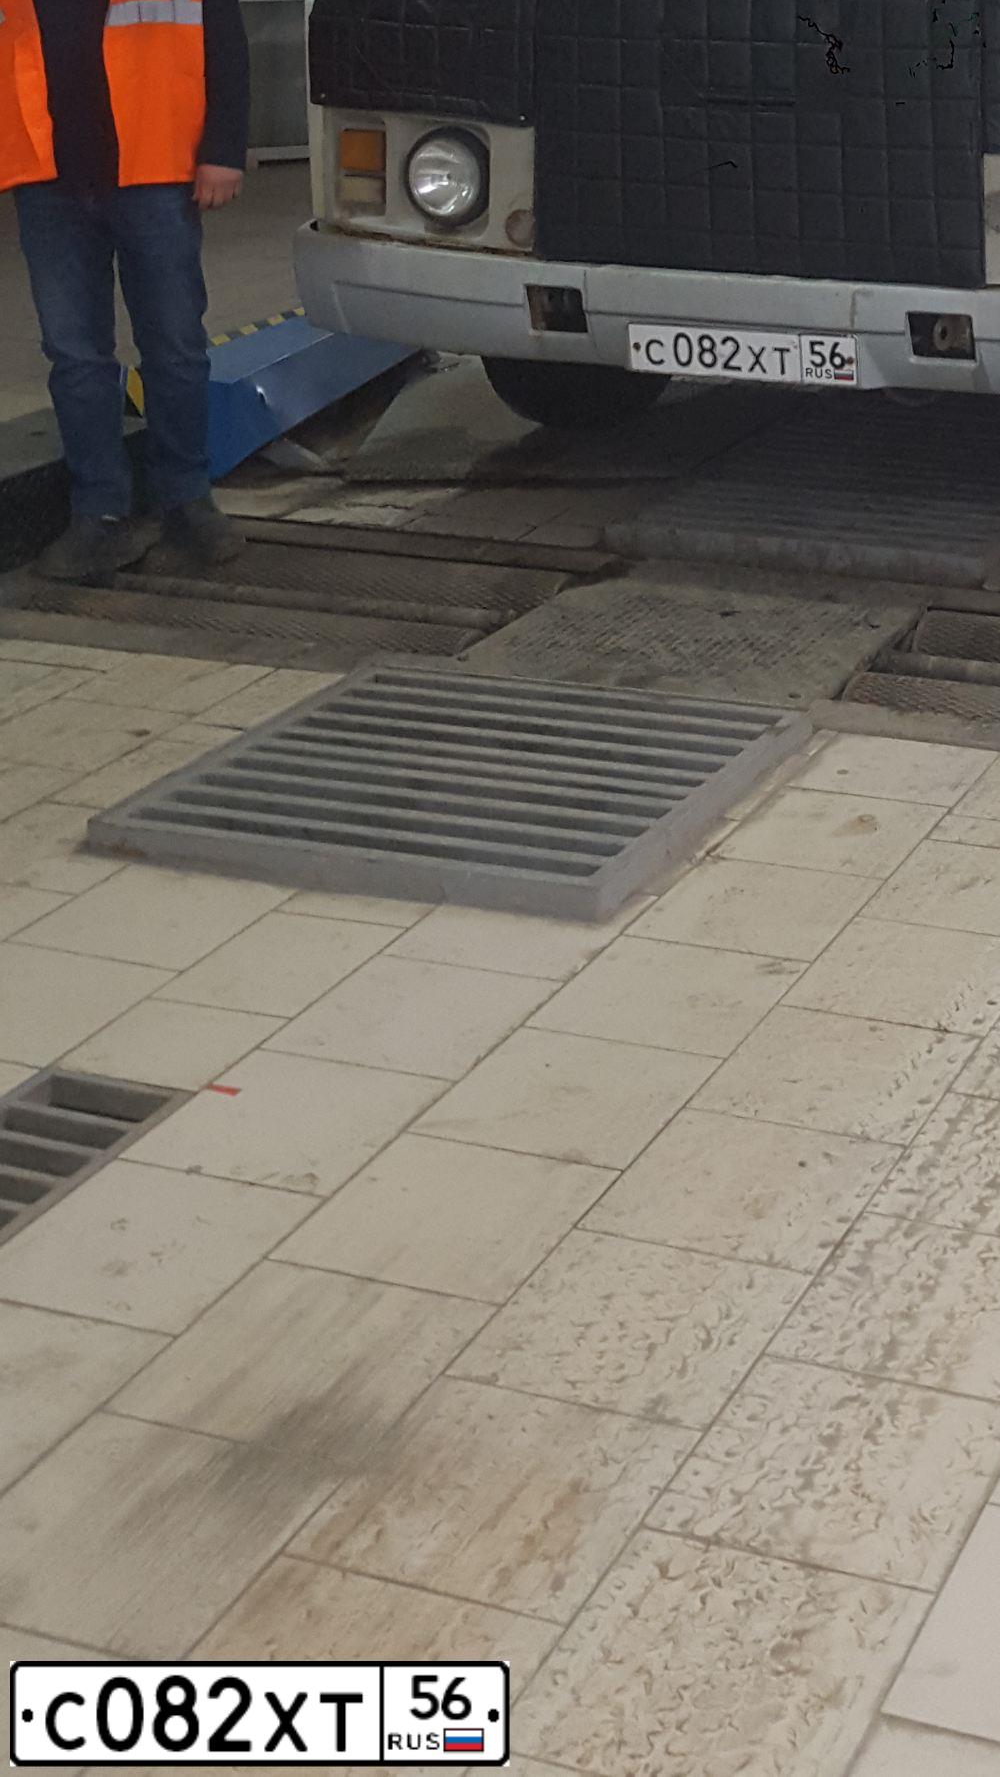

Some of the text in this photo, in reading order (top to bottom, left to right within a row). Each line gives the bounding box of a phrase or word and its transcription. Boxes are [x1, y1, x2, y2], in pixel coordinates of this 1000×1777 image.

[645, 332, 791, 376] С082ХТ
[809, 341, 846, 369] 56
[805, 367, 833, 379] RUS
